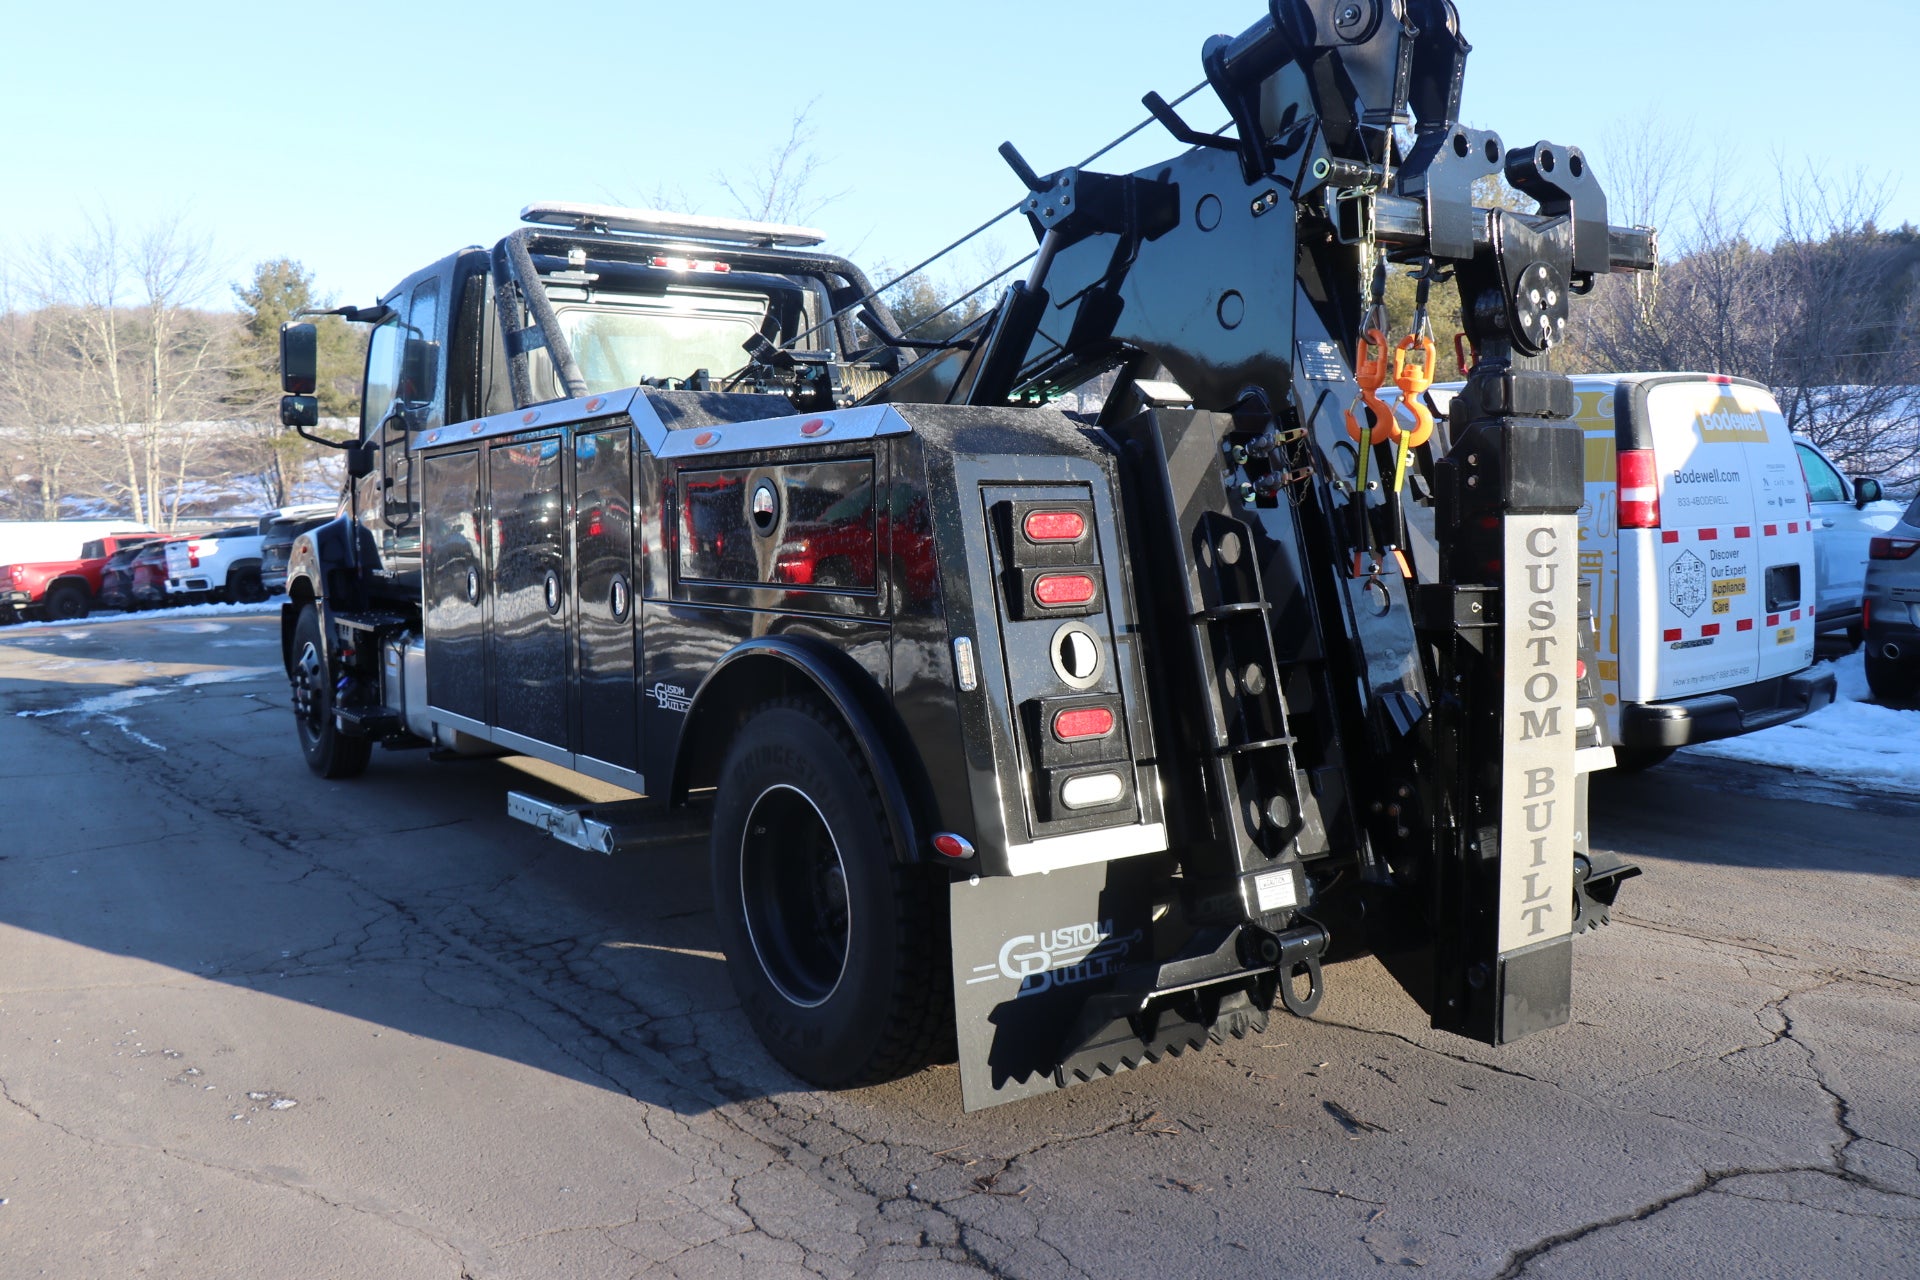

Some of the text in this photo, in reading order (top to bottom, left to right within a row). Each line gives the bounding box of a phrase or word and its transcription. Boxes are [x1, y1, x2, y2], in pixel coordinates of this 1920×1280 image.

[1701, 408, 1763, 431] Bodewell
[1673, 468, 1740, 484] Bodewell.com
[1710, 549, 1740, 560] Discover
[1711, 565, 1747, 577] Our Expert
[1712, 581, 1746, 596] Appliance
[1712, 601, 1729, 612] Care
[654, 682, 685, 701] CUSTOM
[1519, 527, 1561, 937] CUSTOM BUILT
[998, 918, 1113, 979] CUSTOM
[1015, 952, 1112, 999] BUILT
